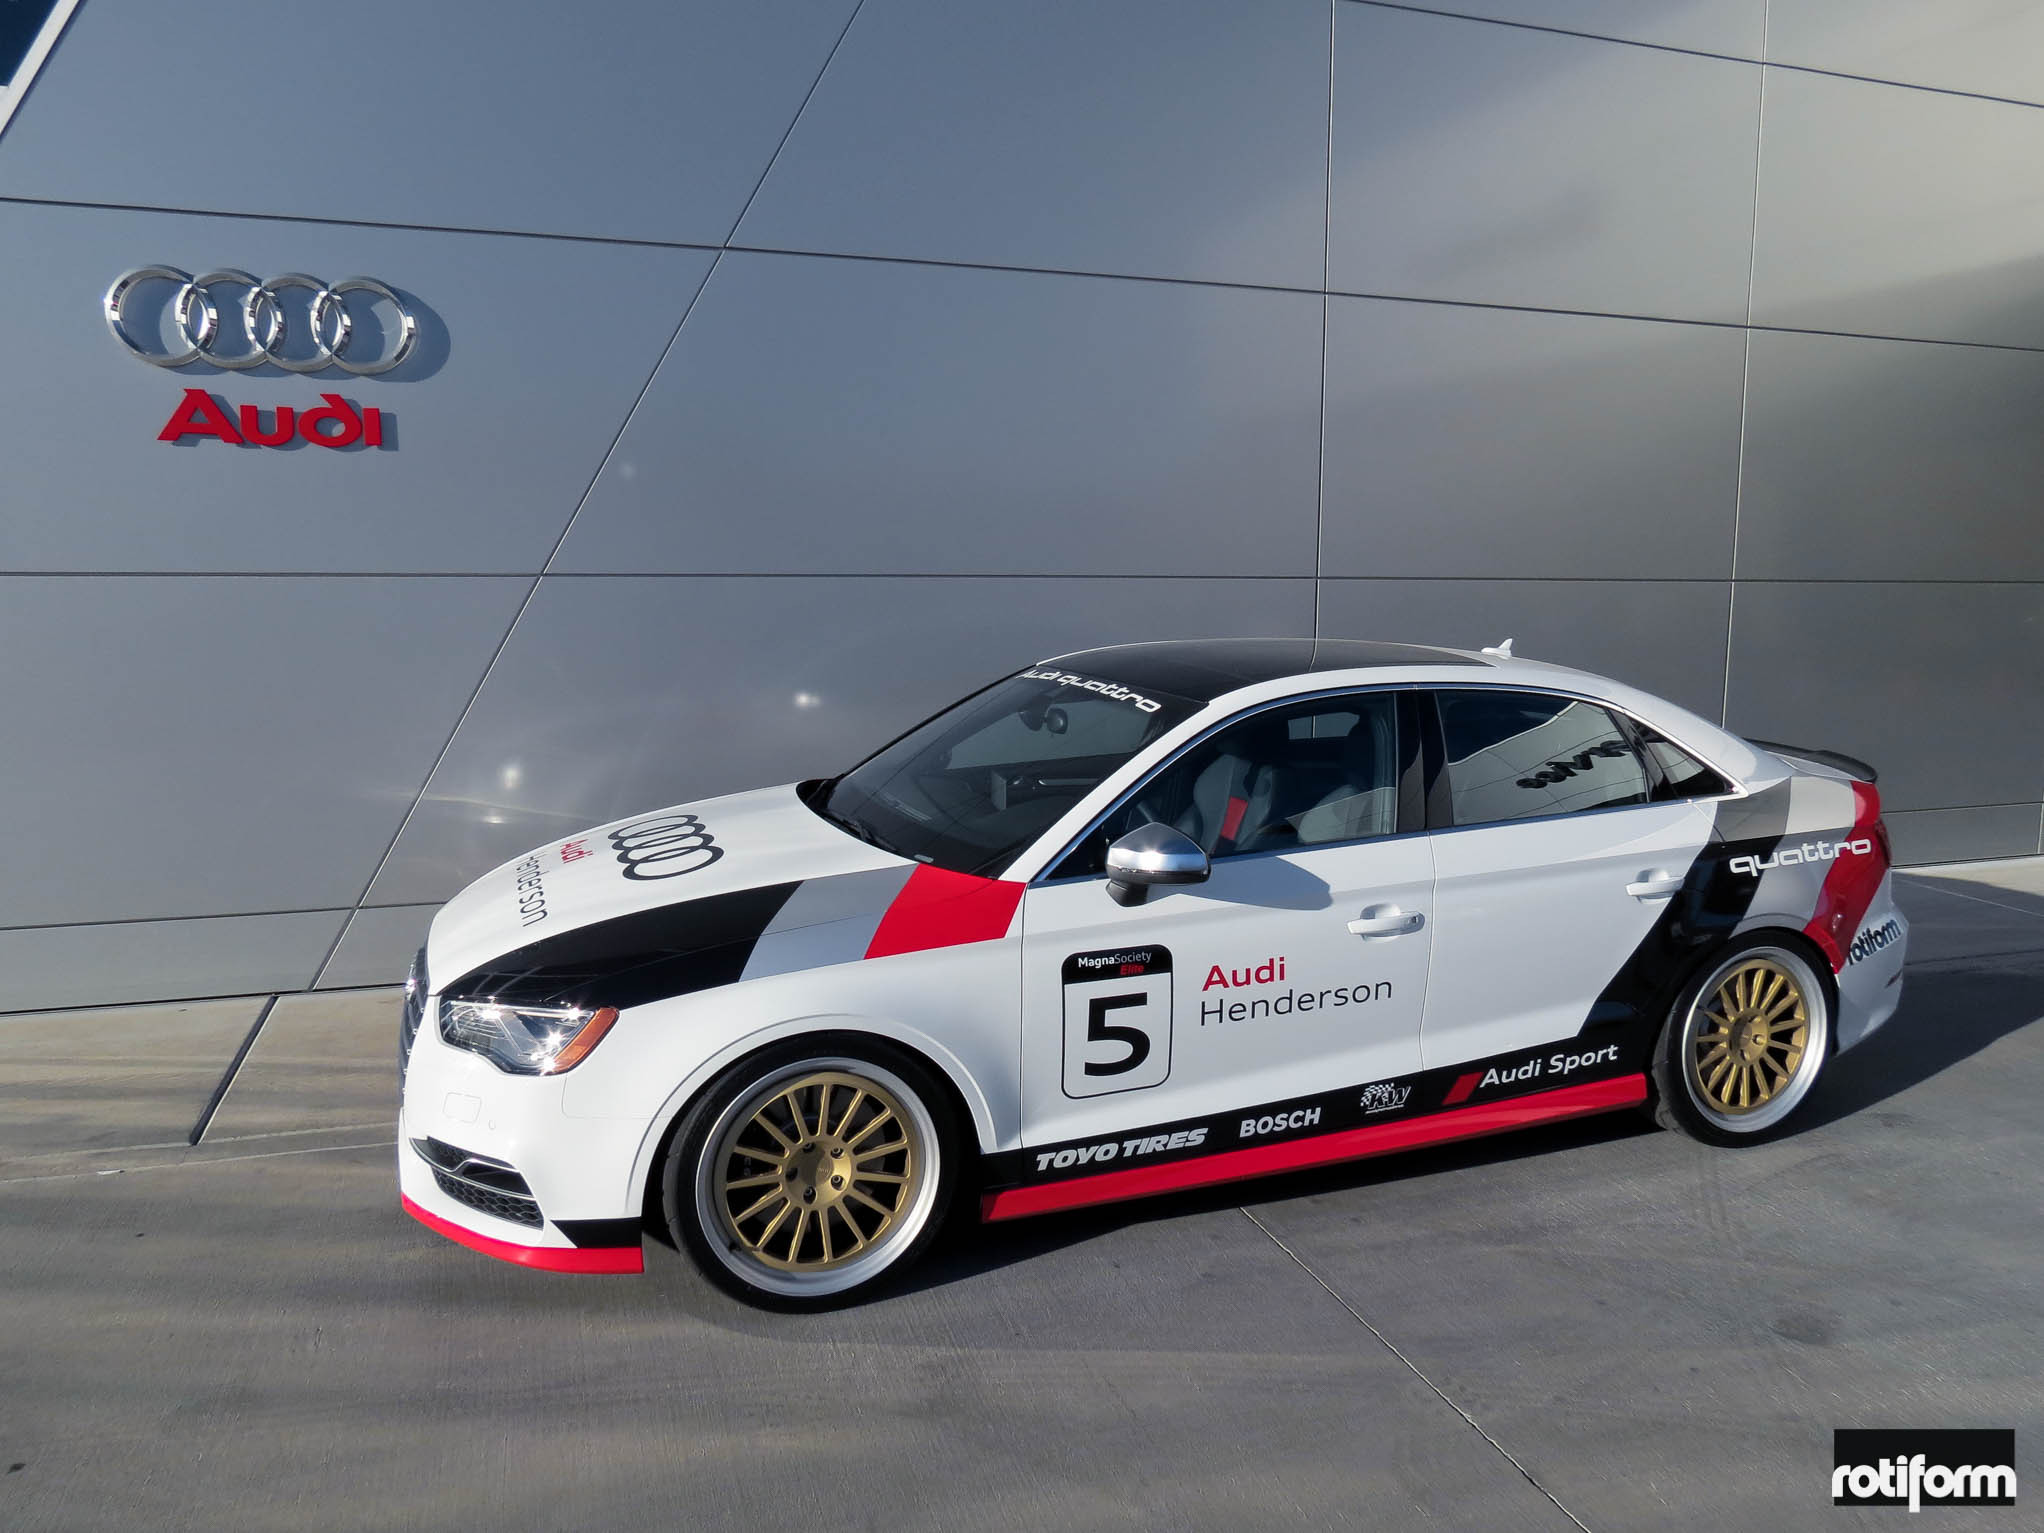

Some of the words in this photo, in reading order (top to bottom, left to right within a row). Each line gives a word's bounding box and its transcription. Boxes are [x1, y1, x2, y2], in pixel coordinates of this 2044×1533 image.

[156, 388, 382, 447] Audi
[1057, 675, 1162, 713] quattro
[560, 839, 594, 864] Audi
[1729, 838, 1872, 877] quattro
[516, 851, 549, 927] Henderson
[1848, 919, 1902, 966] rotiform
[1119, 963, 1145, 976] Elite
[1202, 956, 1286, 992] Audi
[1200, 980, 1393, 1027] Henderson
[1084, 991, 1151, 1077] 5
[1479, 1058, 1542, 1088] Audi
[1547, 1044, 1620, 1075] Sport
[1239, 1107, 1322, 1138] BOSCH
[1036, 1142, 1119, 1172] TOYO
[1122, 1127, 1208, 1158] TIRES
